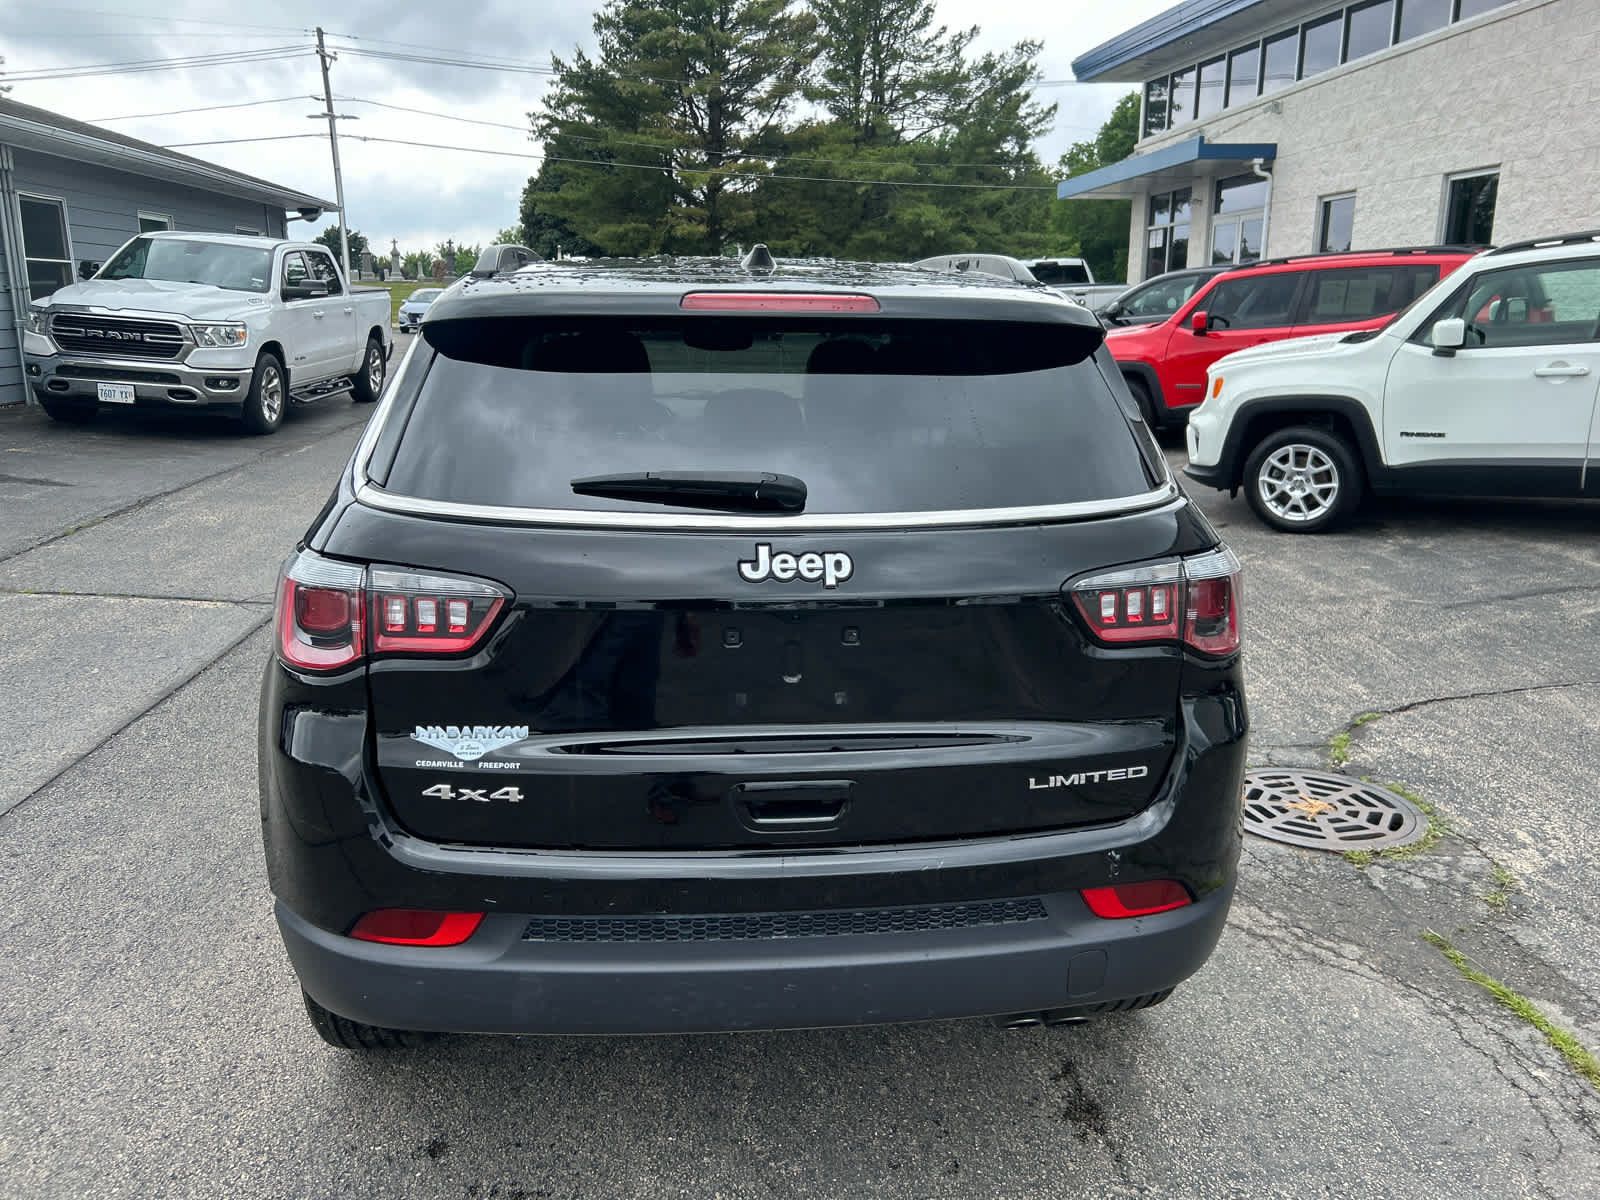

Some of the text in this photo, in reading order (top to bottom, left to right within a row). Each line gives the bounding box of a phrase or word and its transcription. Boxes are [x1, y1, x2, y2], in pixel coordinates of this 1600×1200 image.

[86, 328, 142, 341] RAM
[739, 544, 852, 587] Jeep
[446, 725, 529, 740] BARKAU
[415, 760, 521, 769] CEDARVILLE FREEPORT
[1028, 765, 1149, 789] LIMITED
[421, 784, 525, 802] 4x4
